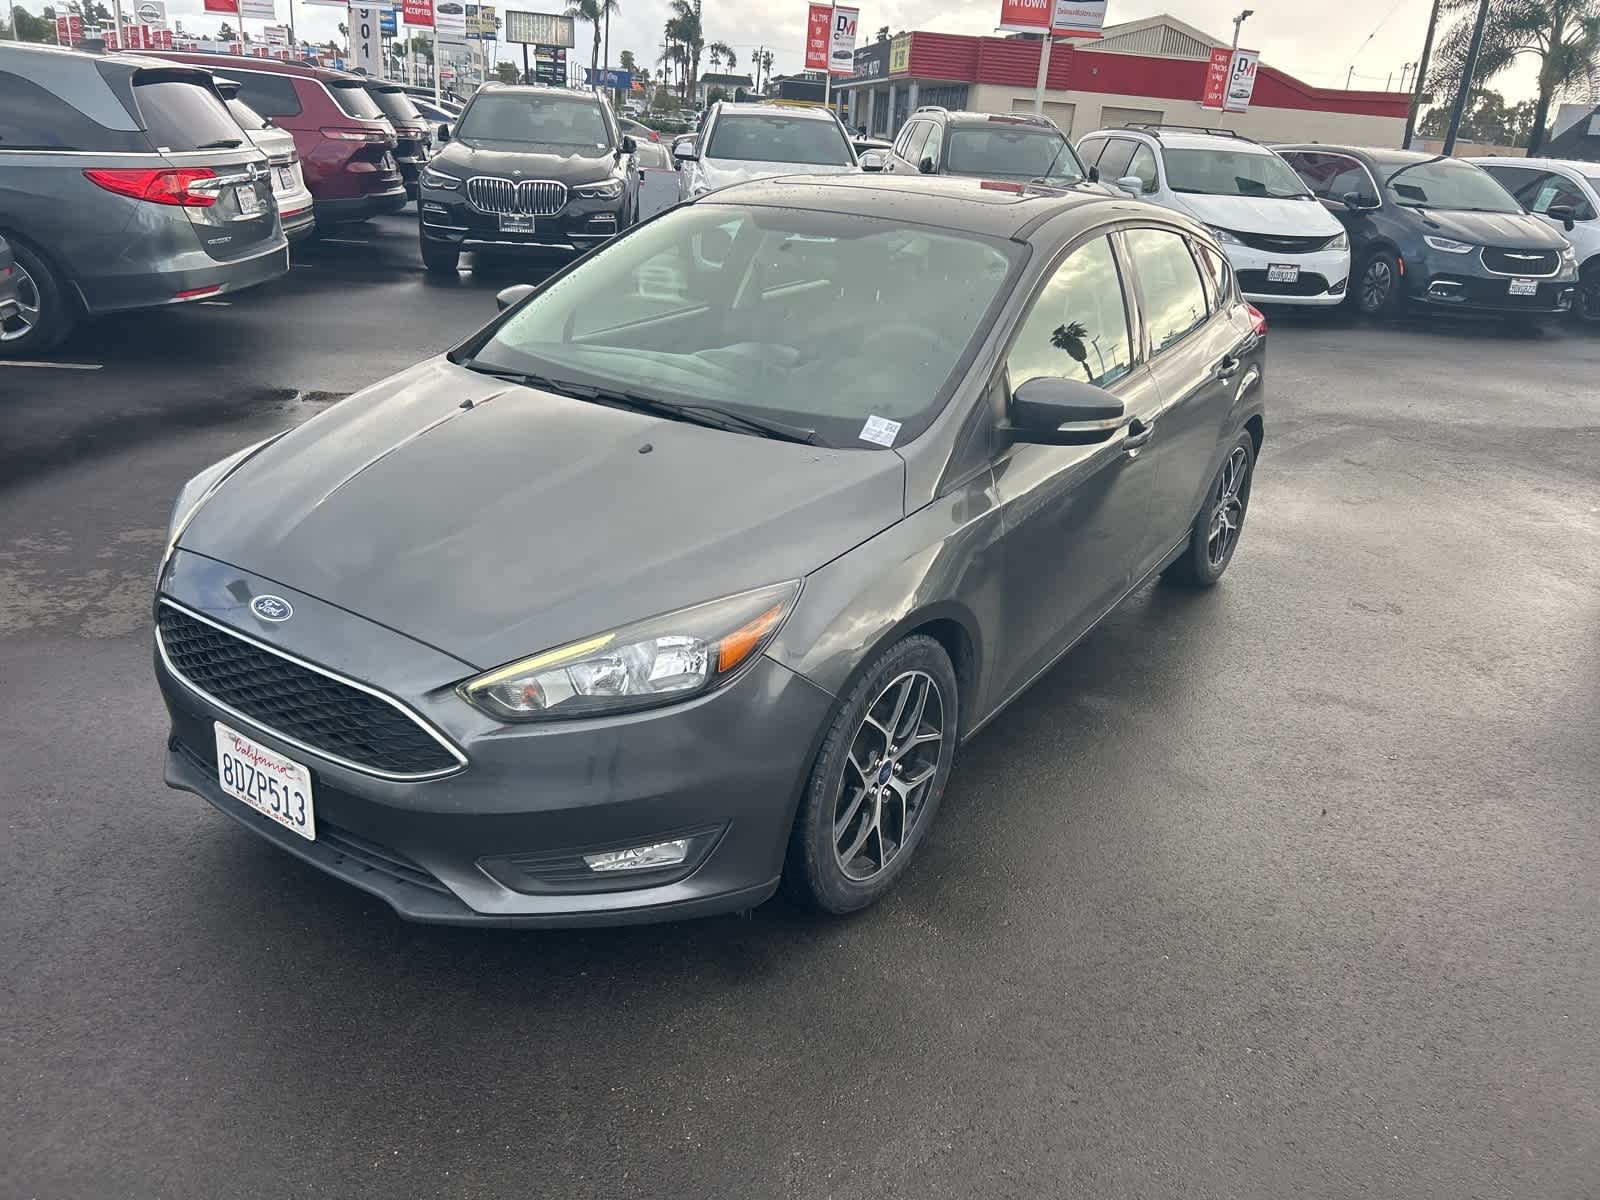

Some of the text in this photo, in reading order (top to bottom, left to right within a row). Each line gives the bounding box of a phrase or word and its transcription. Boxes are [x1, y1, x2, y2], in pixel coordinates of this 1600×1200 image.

[405, 8, 432, 17] ACCEPTED
[258, 599, 284, 617] Ford
[232, 737, 293, 780] California
[223, 753, 306, 826] 8DZP513
